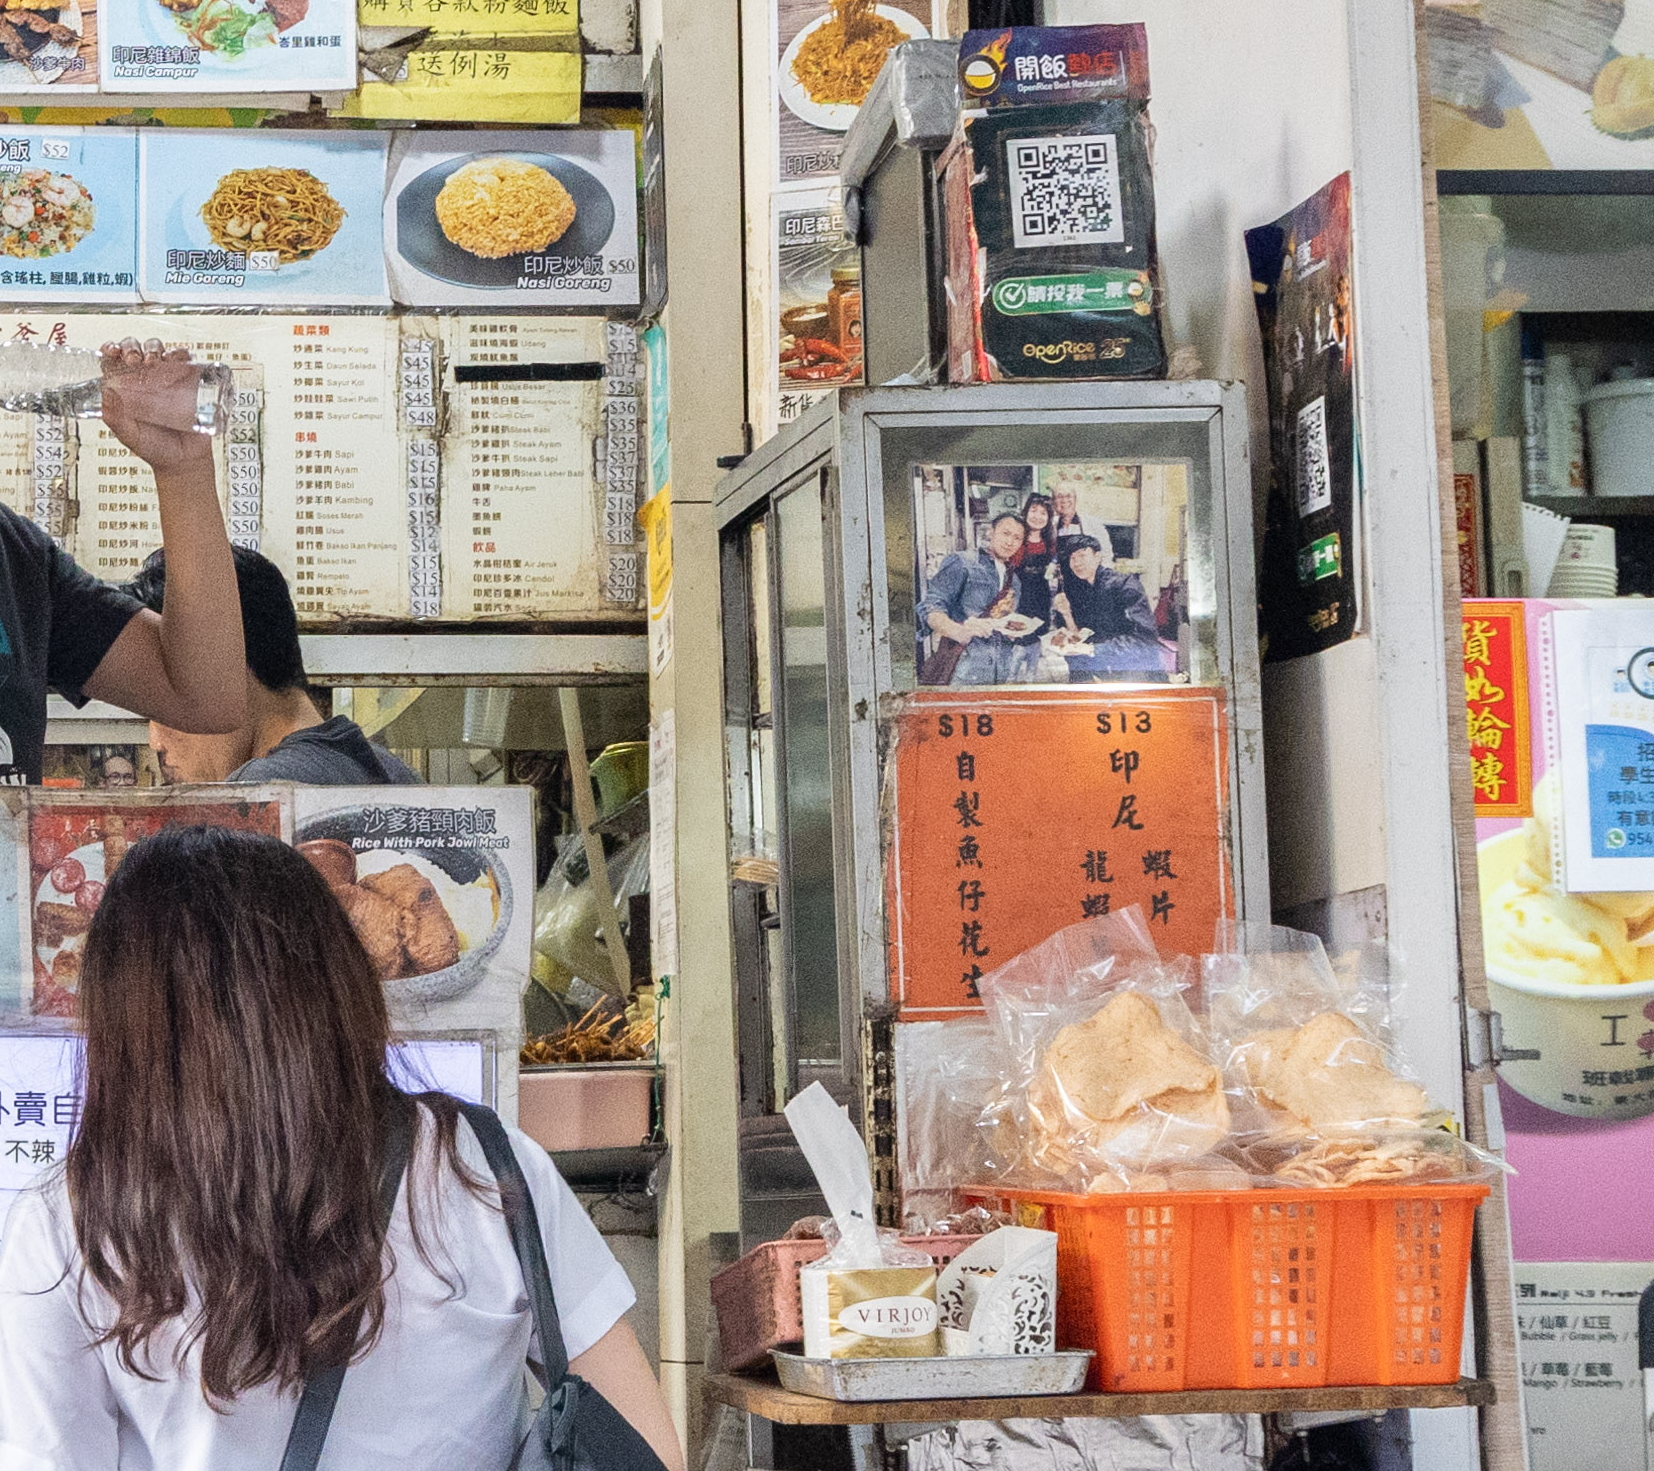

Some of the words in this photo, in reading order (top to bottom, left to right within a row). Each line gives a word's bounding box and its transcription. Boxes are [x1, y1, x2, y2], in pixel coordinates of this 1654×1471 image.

[111, 45, 200, 64] 印尼雜錦飯
[114, 65, 145, 78] Nasi
[146, 65, 197, 79] Campur
[417, 53, 511, 79] 送例湯
[42, 142, 68, 159] $52
[166, 250, 246, 271] 印尼炒麵
[524, 255, 603, 276] 印尼炒飯
[609, 258, 636, 274] $50
[165, 271, 192, 285] Mie
[193, 271, 245, 287] Goreng
[516, 276, 551, 290] Nasi
[553, 276, 610, 291] Goreng
[938, 712, 994, 736] $18
[1097, 711, 1152, 734] $13
[363, 808, 496, 833] 沙爹豬頸肉飯
[352, 837, 381, 848] Rice
[383, 837, 412, 848] With
[415, 837, 444, 848] Pork
[447, 837, 476, 848] Jowl
[479, 837, 509, 848] Meat
[5, 1139, 55, 1164] 不辣
[858, 1305, 932, 1324] VIRJOY
